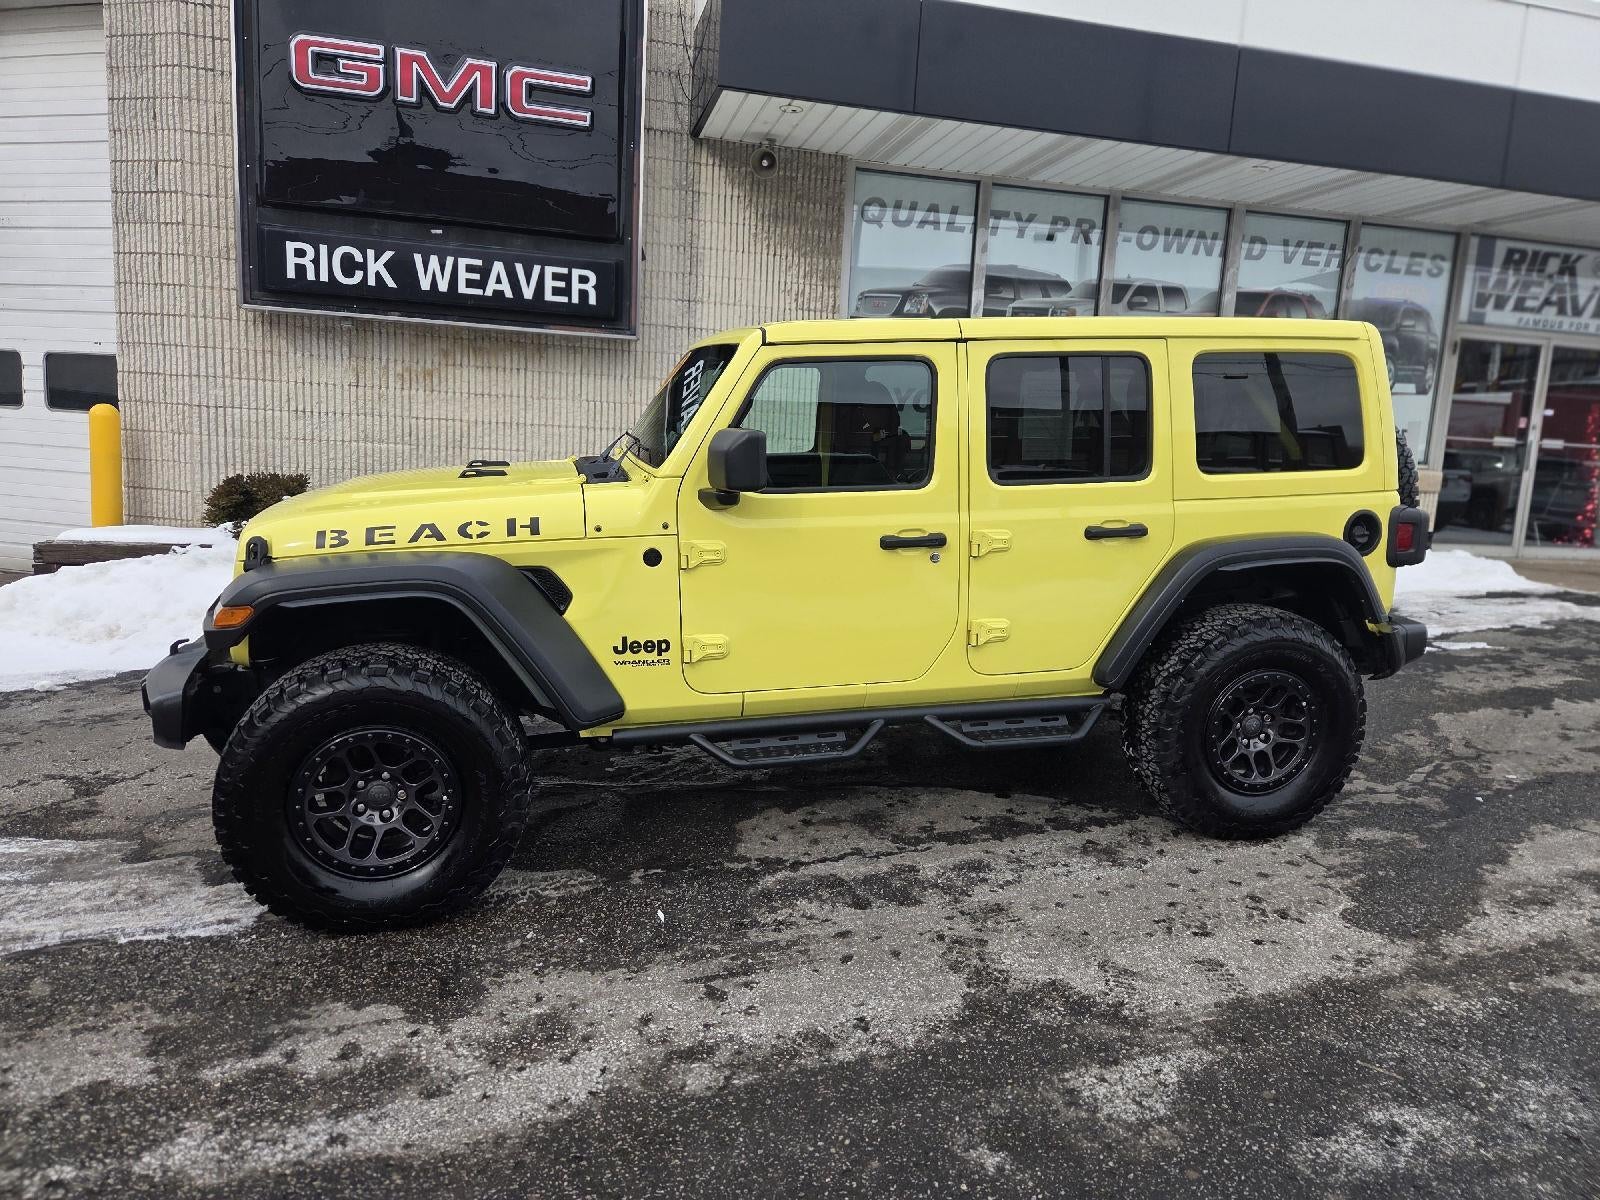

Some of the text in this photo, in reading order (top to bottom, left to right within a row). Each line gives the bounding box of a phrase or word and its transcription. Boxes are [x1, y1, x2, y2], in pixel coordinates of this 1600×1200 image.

[290, 33, 594, 128] GMC
[1045, 215, 1268, 261] PR-OWND
[285, 240, 597, 305] RICK WEAVER
[1501, 247, 1587, 277] RICK
[1474, 272, 1600, 320] WEAV
[315, 516, 541, 550] BEACH
[612, 636, 671, 657] Jeep
[613, 658, 671, 666] WRANGLER
